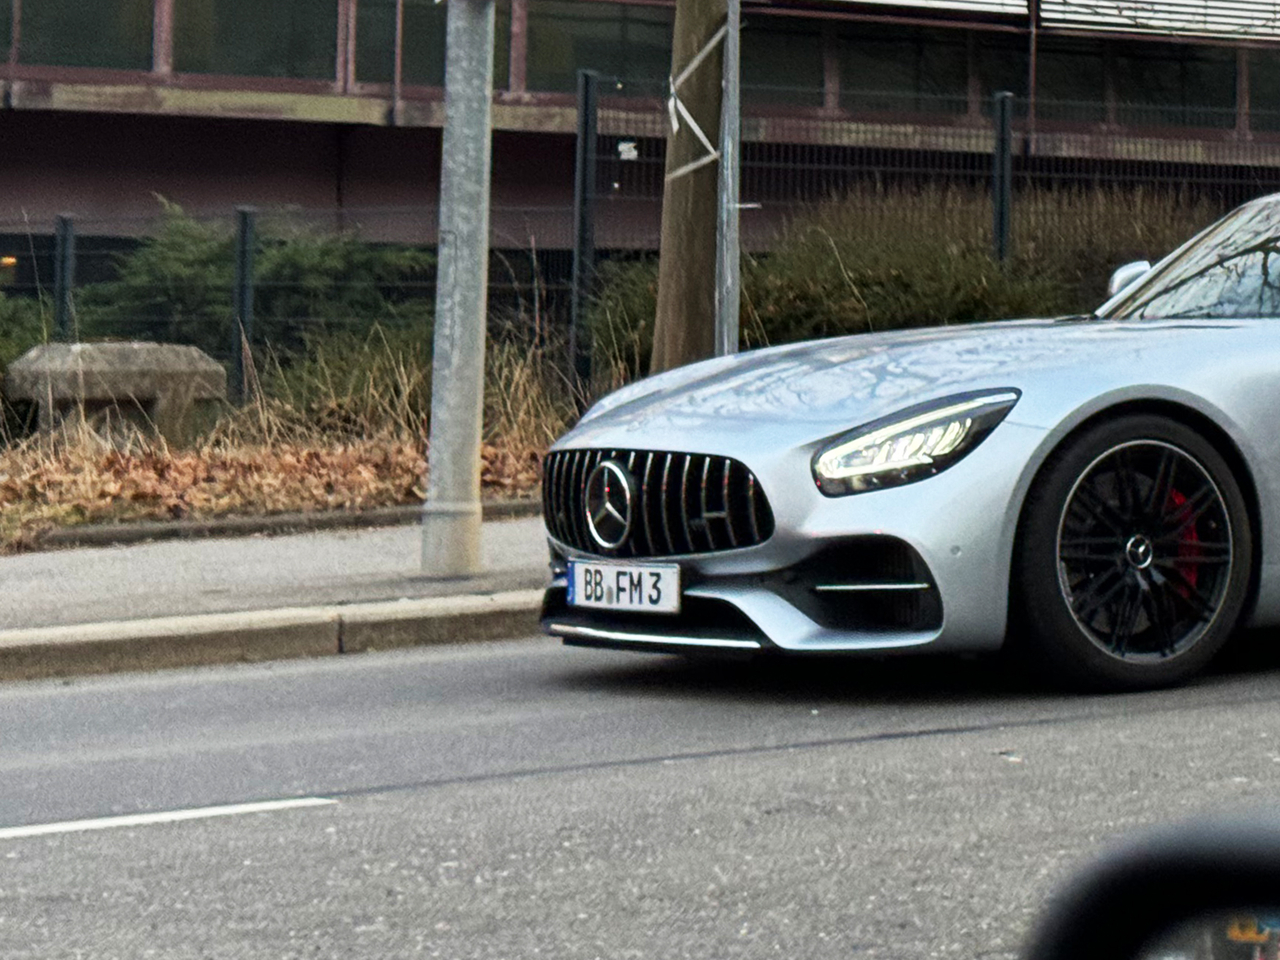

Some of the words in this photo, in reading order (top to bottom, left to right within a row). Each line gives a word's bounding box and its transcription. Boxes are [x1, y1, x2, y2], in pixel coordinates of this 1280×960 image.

[584, 568, 604, 602] BB
[616, 570, 643, 605] FM
[648, 572, 662, 605] 3
